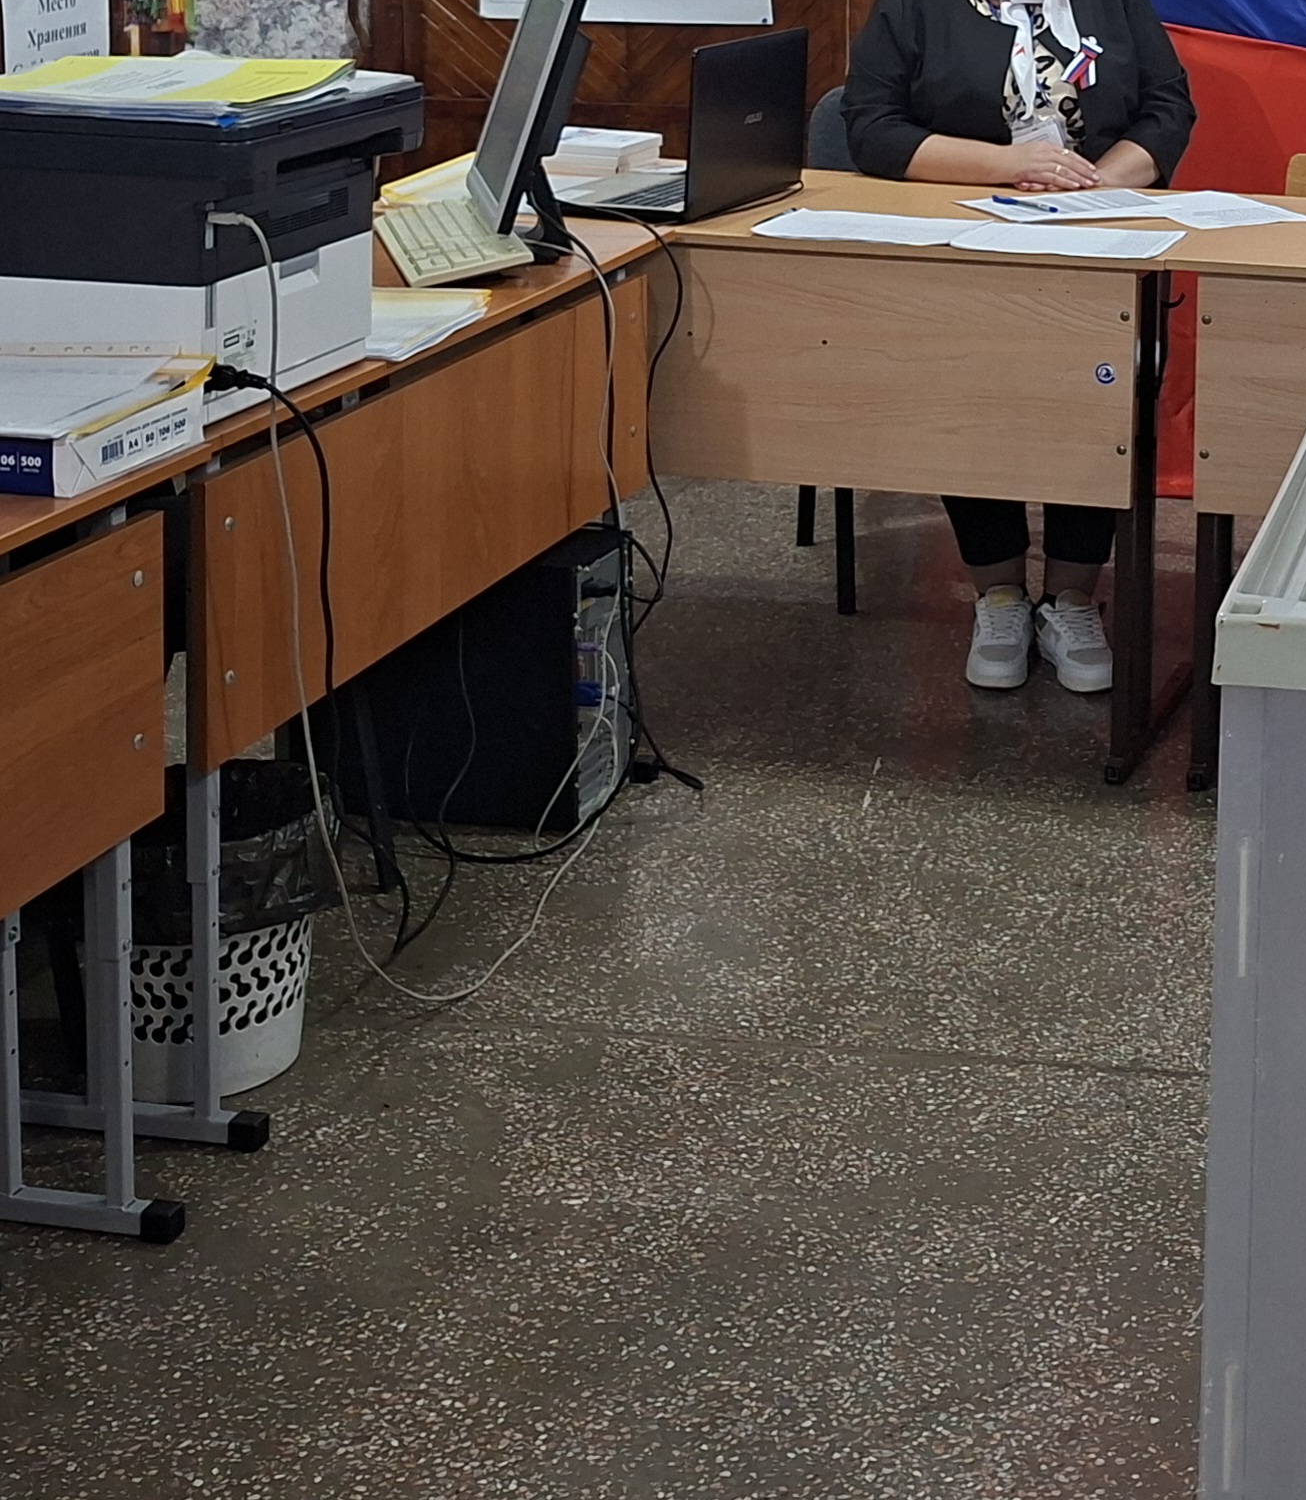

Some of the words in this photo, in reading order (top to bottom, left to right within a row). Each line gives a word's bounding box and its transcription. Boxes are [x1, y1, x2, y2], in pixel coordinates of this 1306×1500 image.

[27, 22, 87, 51] Хранения
[174, 418, 186, 431] 500
[20, 455, 42, 467] 500
